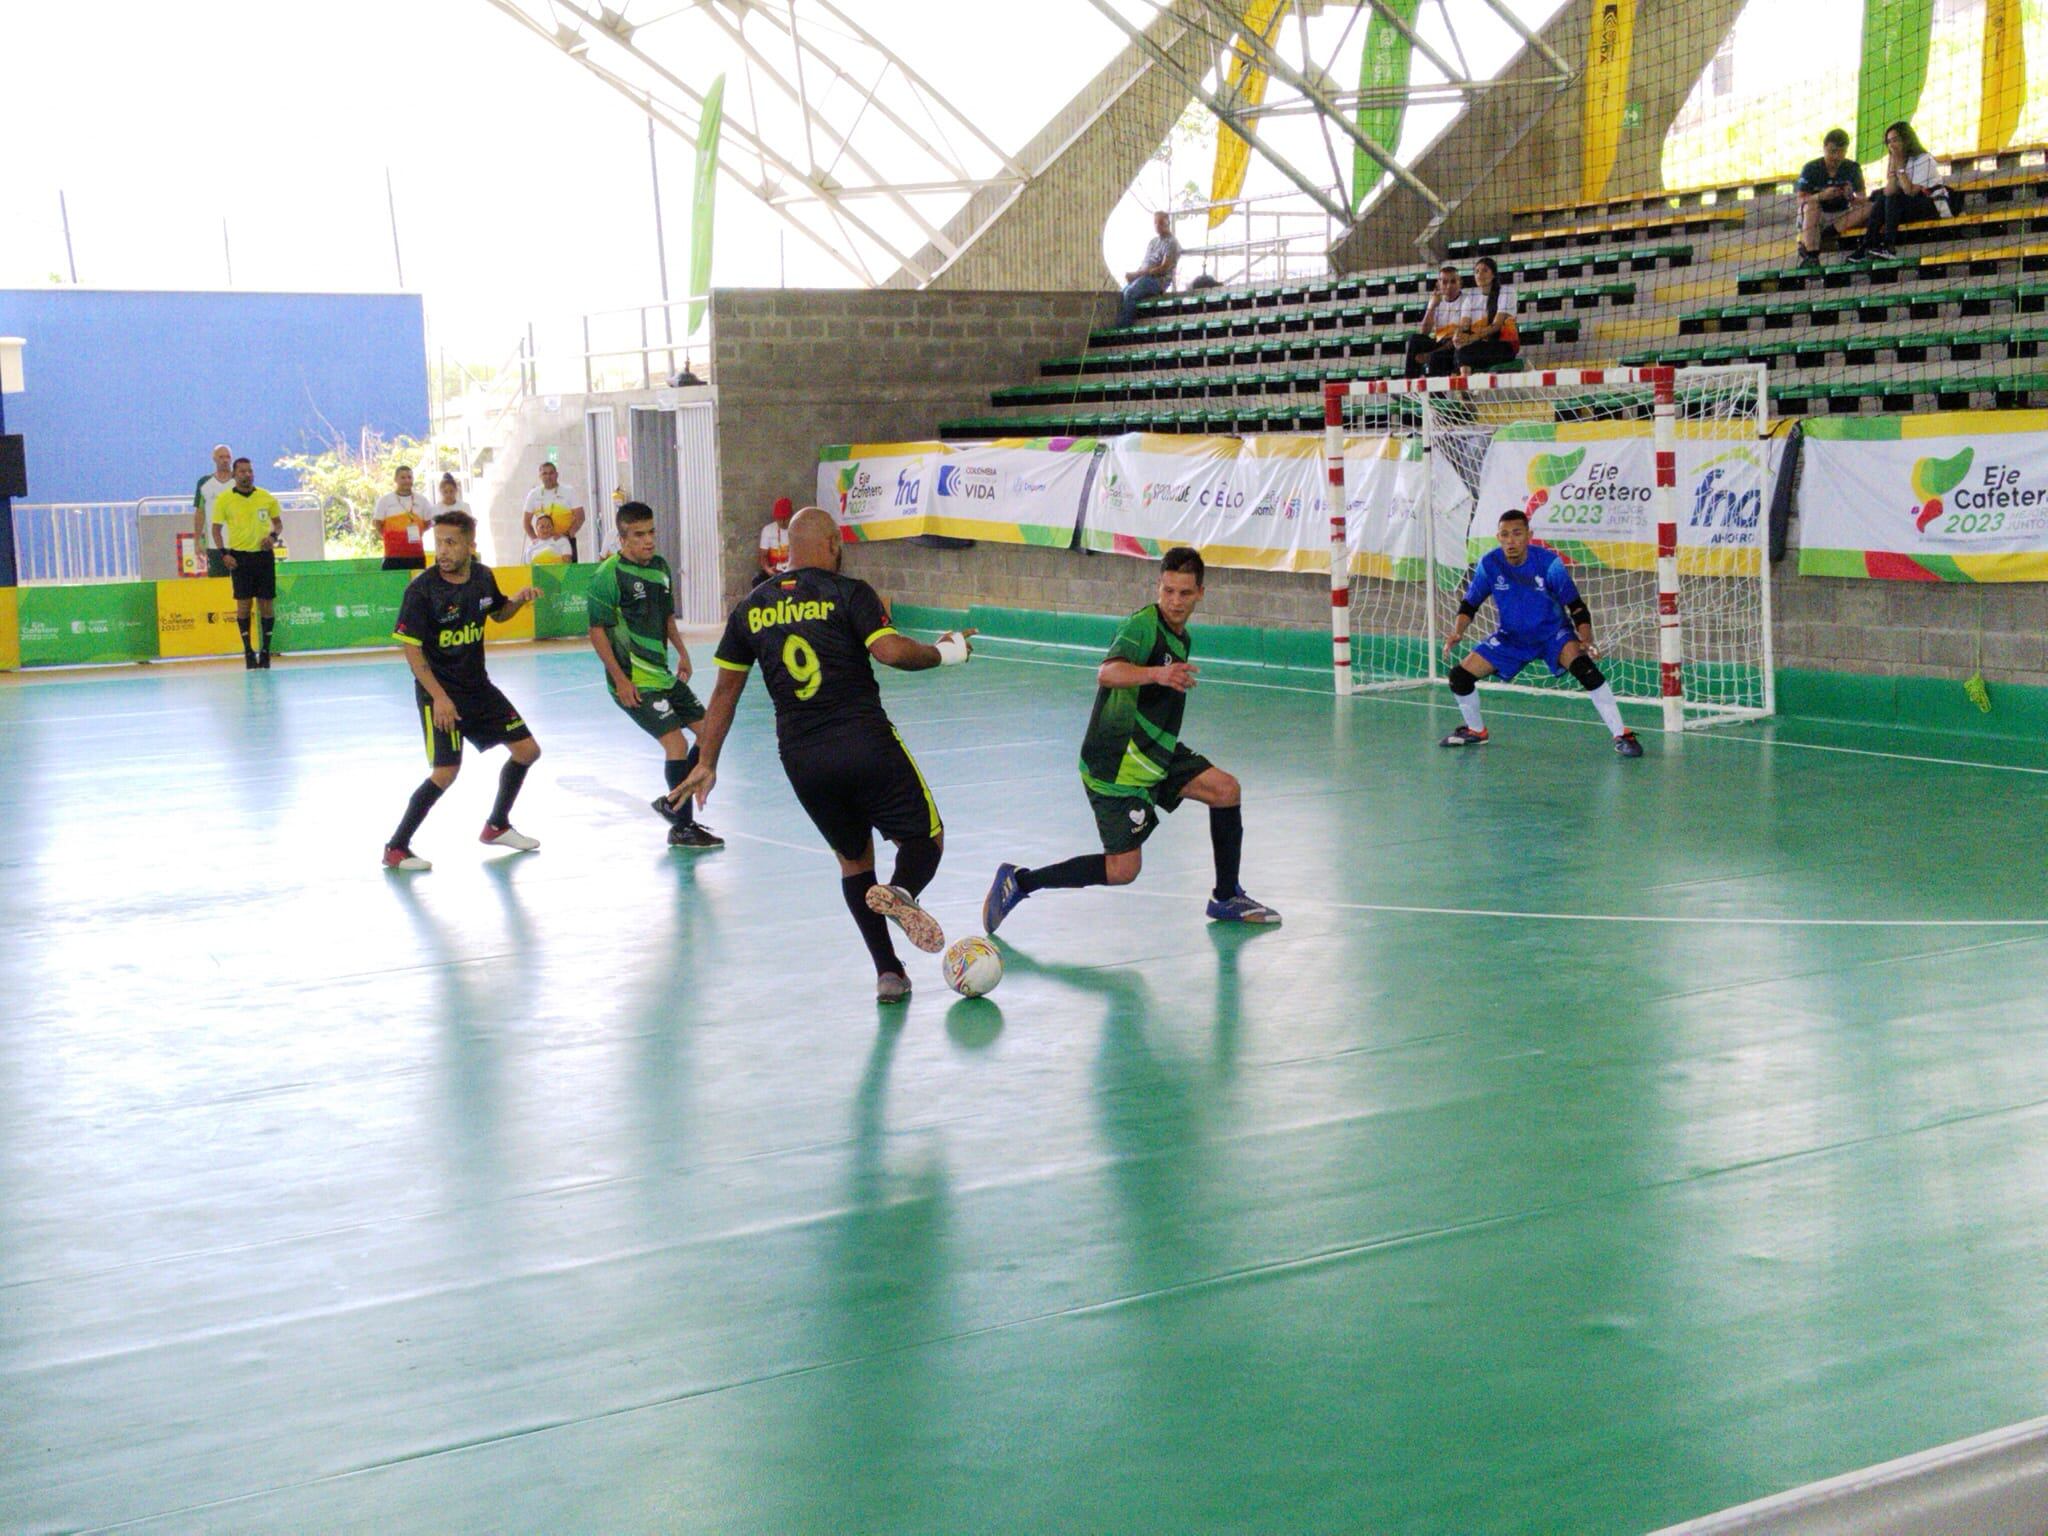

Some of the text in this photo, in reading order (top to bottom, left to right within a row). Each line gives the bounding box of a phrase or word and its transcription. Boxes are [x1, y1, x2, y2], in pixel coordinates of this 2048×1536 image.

[859, 472, 871, 487] Eje
[1588, 462, 1619, 483] Eje
[1984, 465, 2020, 490] Eje
[852, 486, 882, 499] Cafetero
[895, 468, 920, 506] fna
[965, 484, 995, 500] VIDA
[1560, 482, 1652, 502] Cafetero
[1690, 468, 1760, 527] fna
[1954, 486, 2048, 509] Cafeter
[1548, 503, 1604, 524] 2023
[1944, 511, 2005, 533] 2023
[2004, 519, 2048, 530] JUNTO
[748, 596, 834, 634] Bolívar
[782, 634, 822, 700] 9
